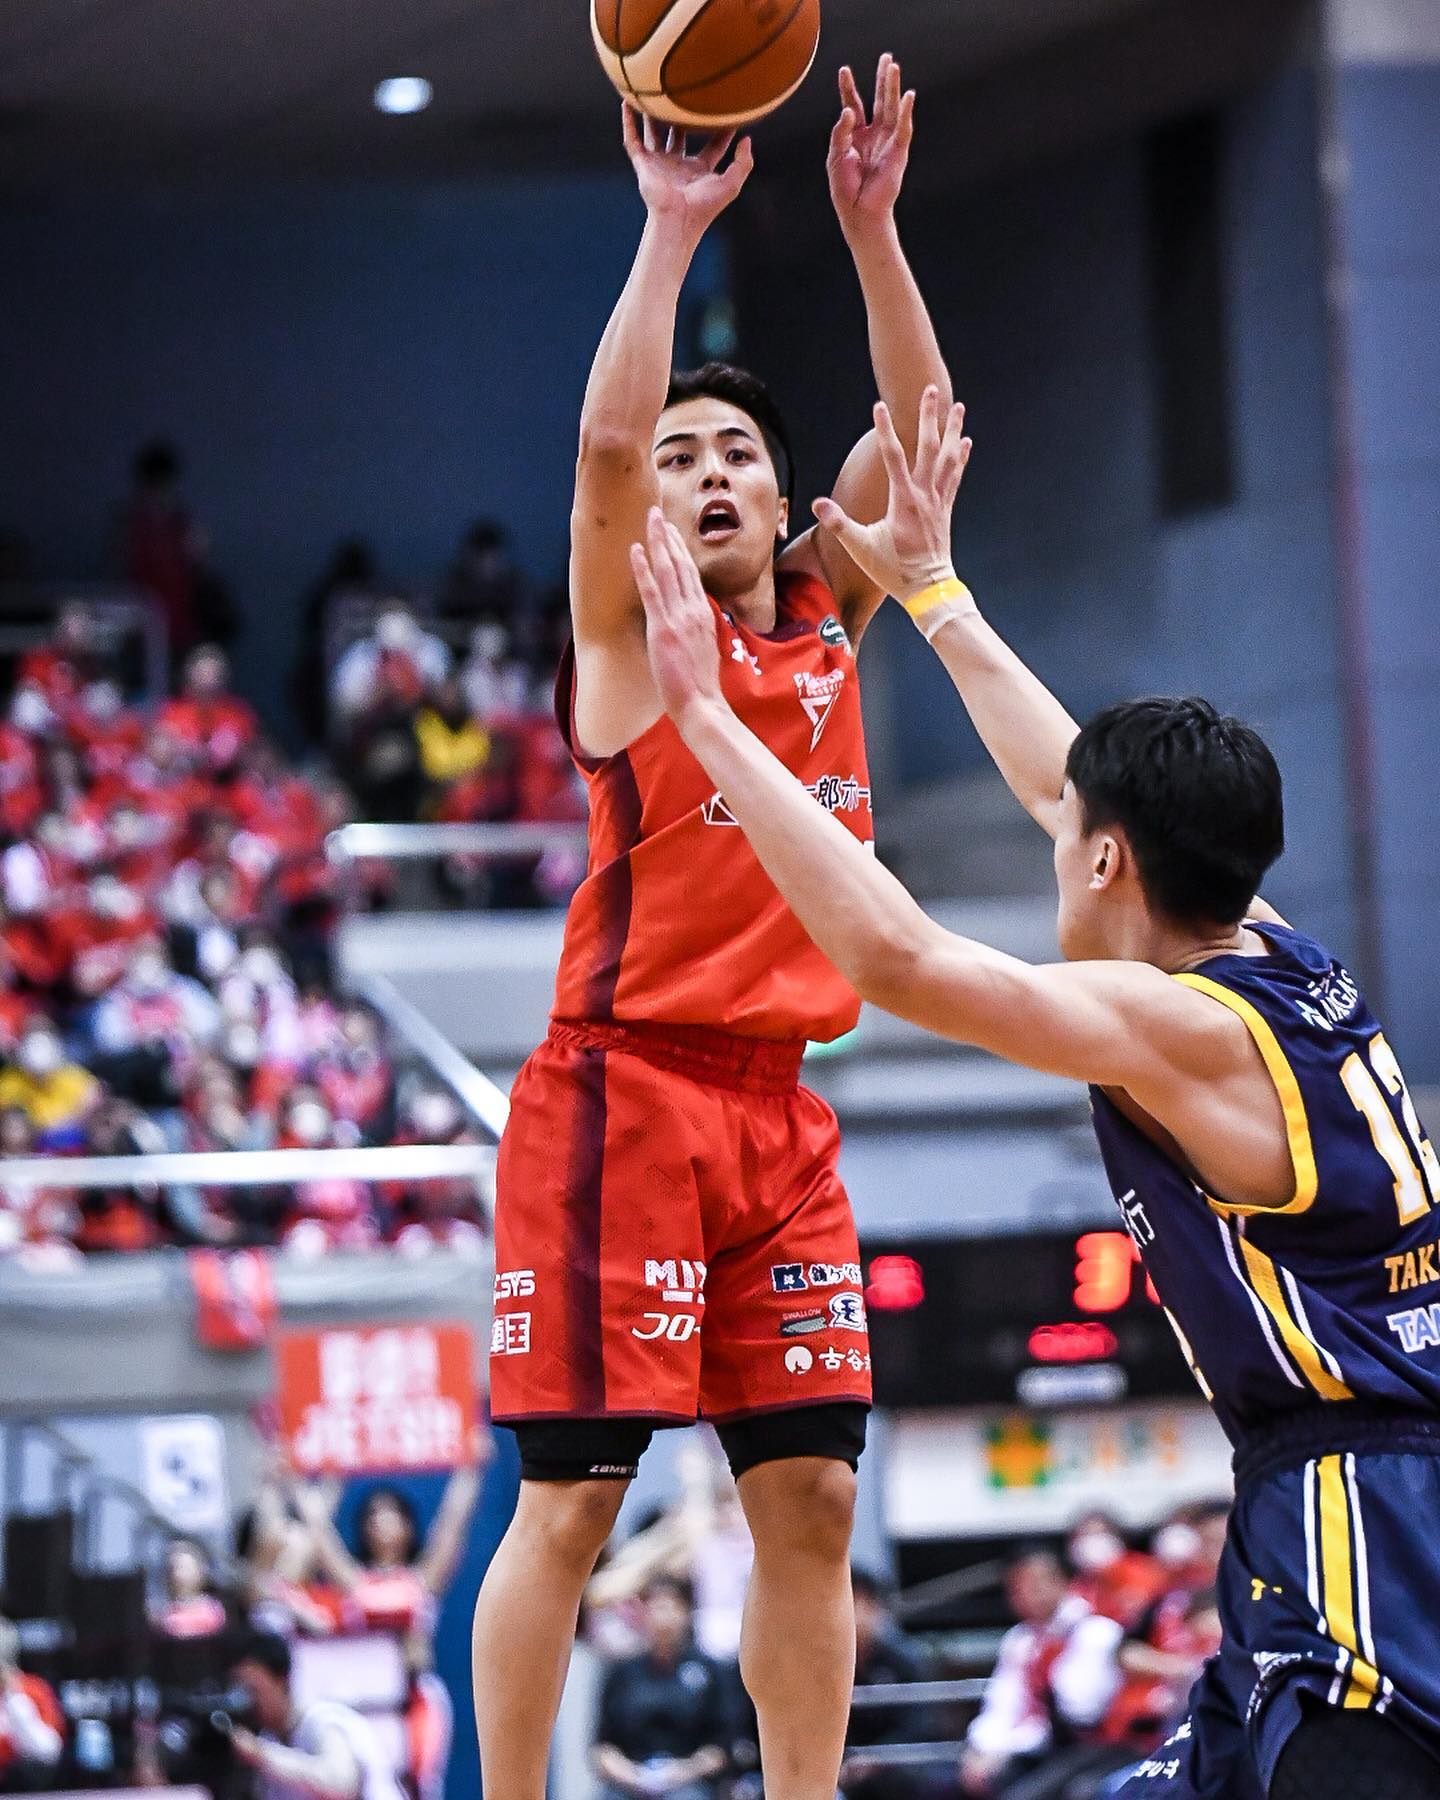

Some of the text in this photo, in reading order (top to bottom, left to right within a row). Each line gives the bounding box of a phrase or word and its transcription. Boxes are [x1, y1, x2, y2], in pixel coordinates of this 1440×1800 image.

[1384, 1239, 1440, 1293] TAK
[493, 1269, 536, 1304] SYS
[782, 1308, 822, 1321] SWALLOW
